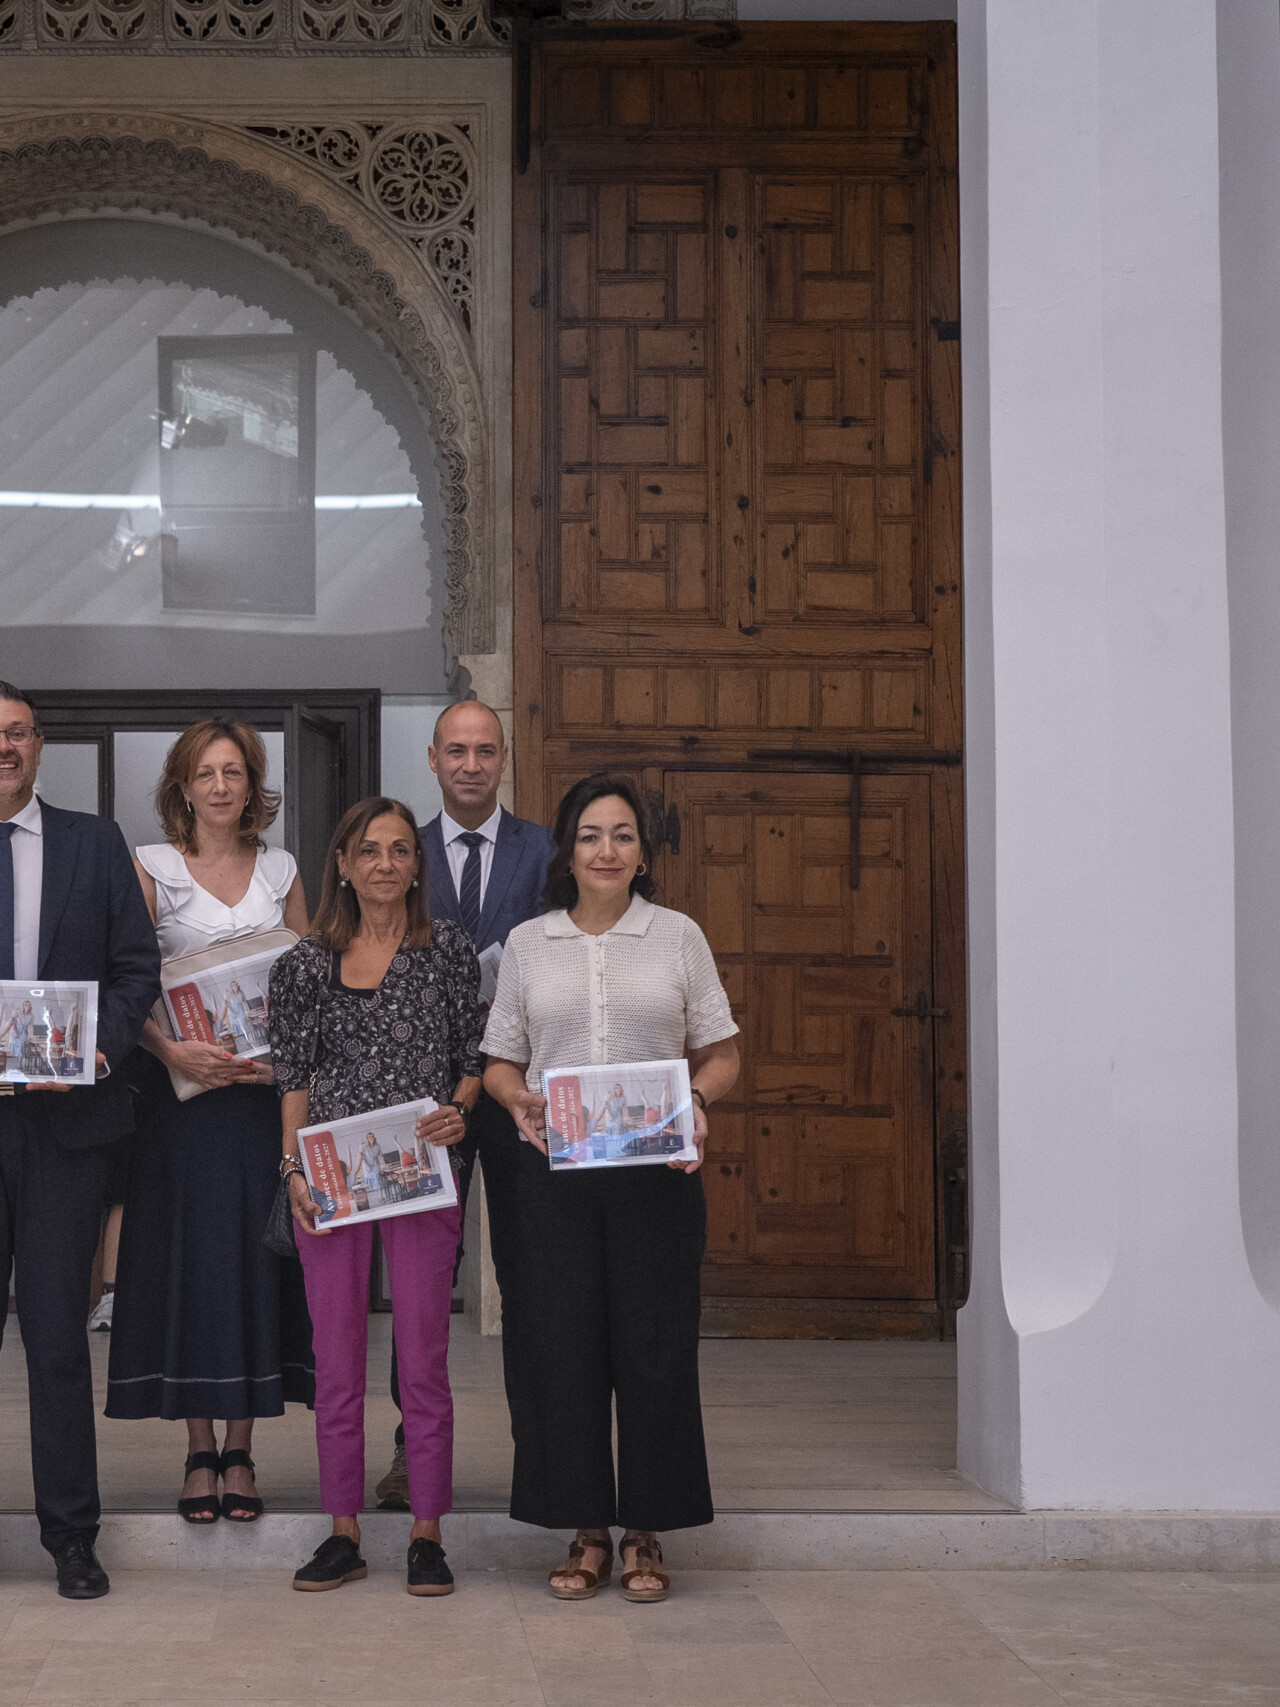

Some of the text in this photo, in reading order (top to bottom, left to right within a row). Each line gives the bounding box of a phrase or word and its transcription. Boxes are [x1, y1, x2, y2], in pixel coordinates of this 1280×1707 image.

[179, 995, 194, 1030] de datos
[558, 1086, 566, 1109] datos
[559, 1112, 567, 1121] de
[313, 1144, 335, 1212] Avance de datos
